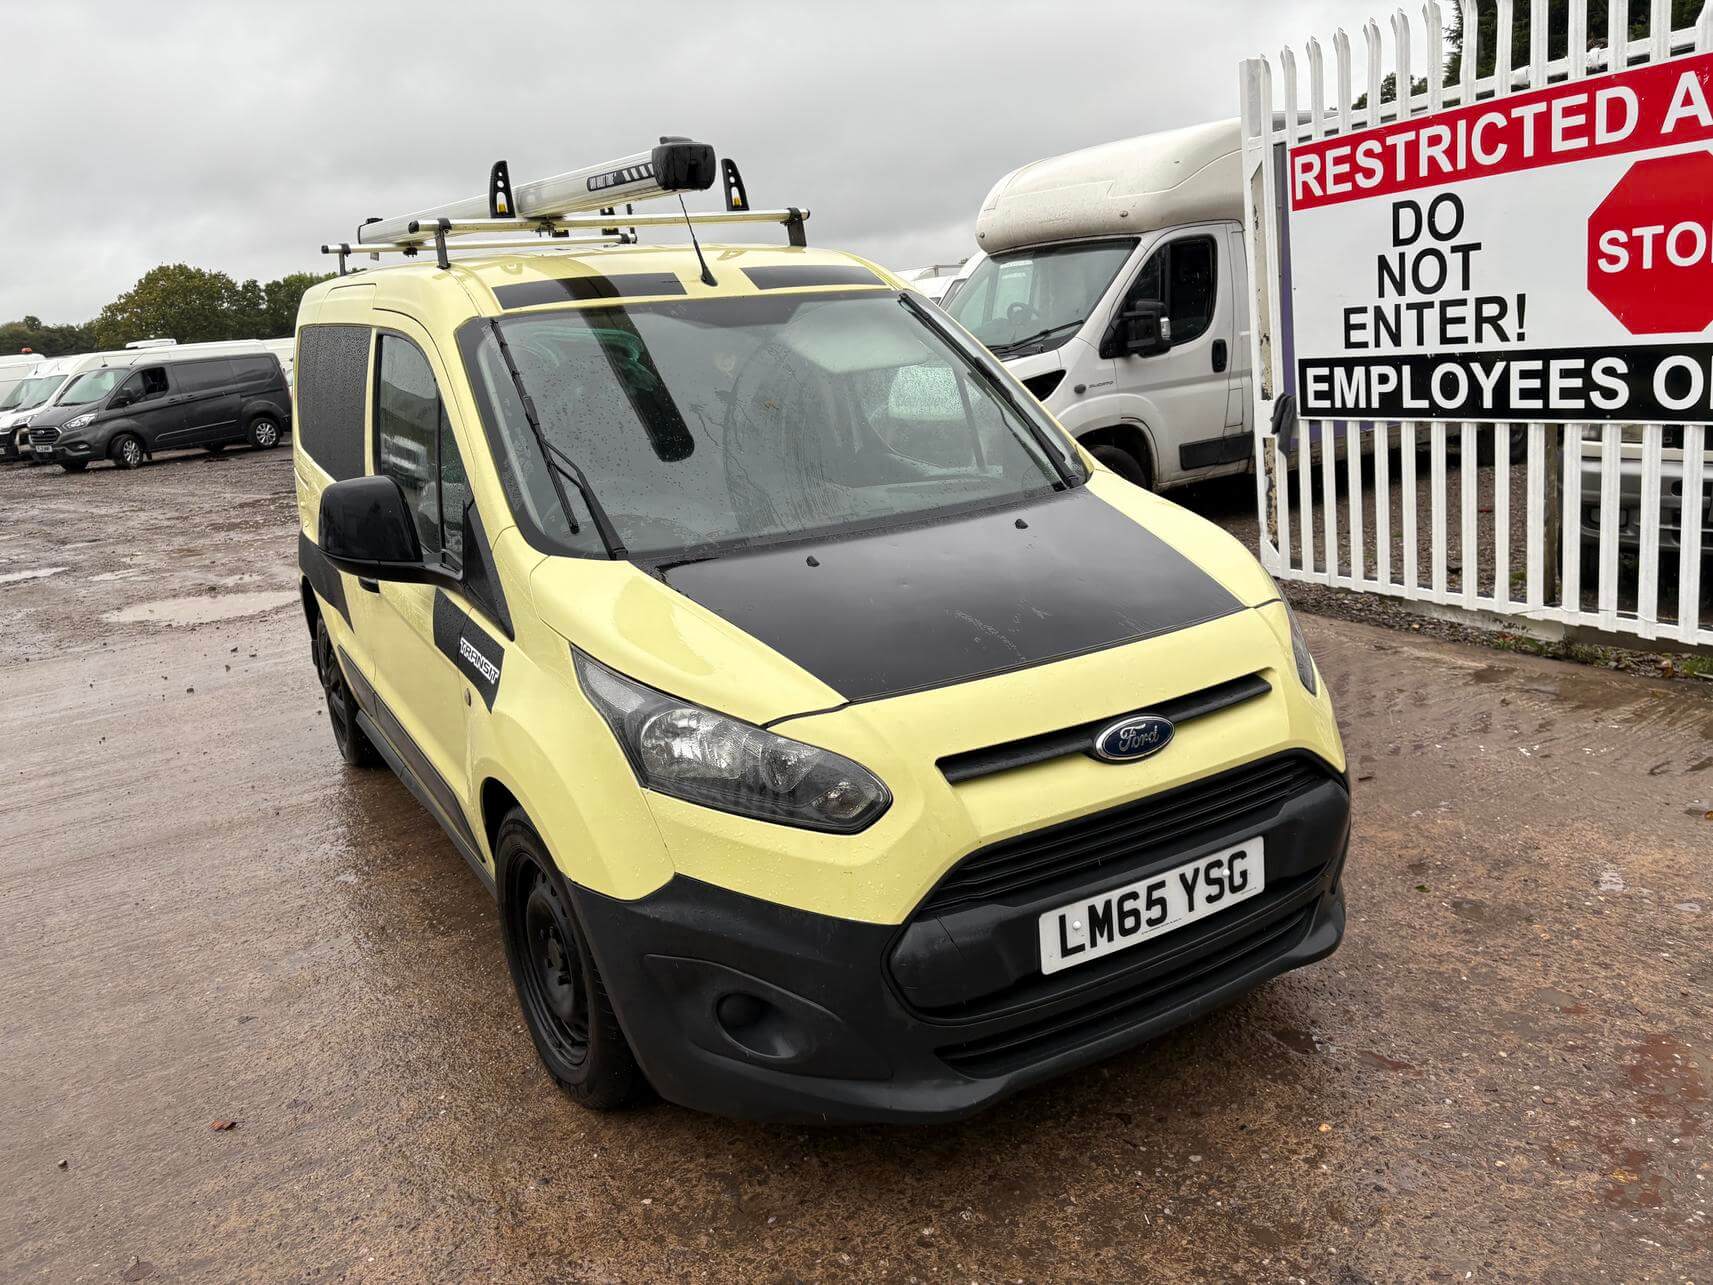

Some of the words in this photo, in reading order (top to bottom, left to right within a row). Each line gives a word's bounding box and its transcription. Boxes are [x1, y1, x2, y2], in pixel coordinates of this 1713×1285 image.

[1294, 86, 1639, 200] RESTRICTED
[1392, 192, 1465, 248] DO
[1598, 221, 1713, 274] STO
[1377, 242, 1482, 298] NOT
[1343, 293, 1526, 350] ENTER!
[1305, 355, 1631, 410] EMPLOYEES
[1653, 355, 1713, 410] O
[460, 637, 499, 684] TRANSIT
[1119, 723, 1160, 752] Ford
[1058, 880, 1168, 959] LM65
[1179, 850, 1248, 913] YSG
